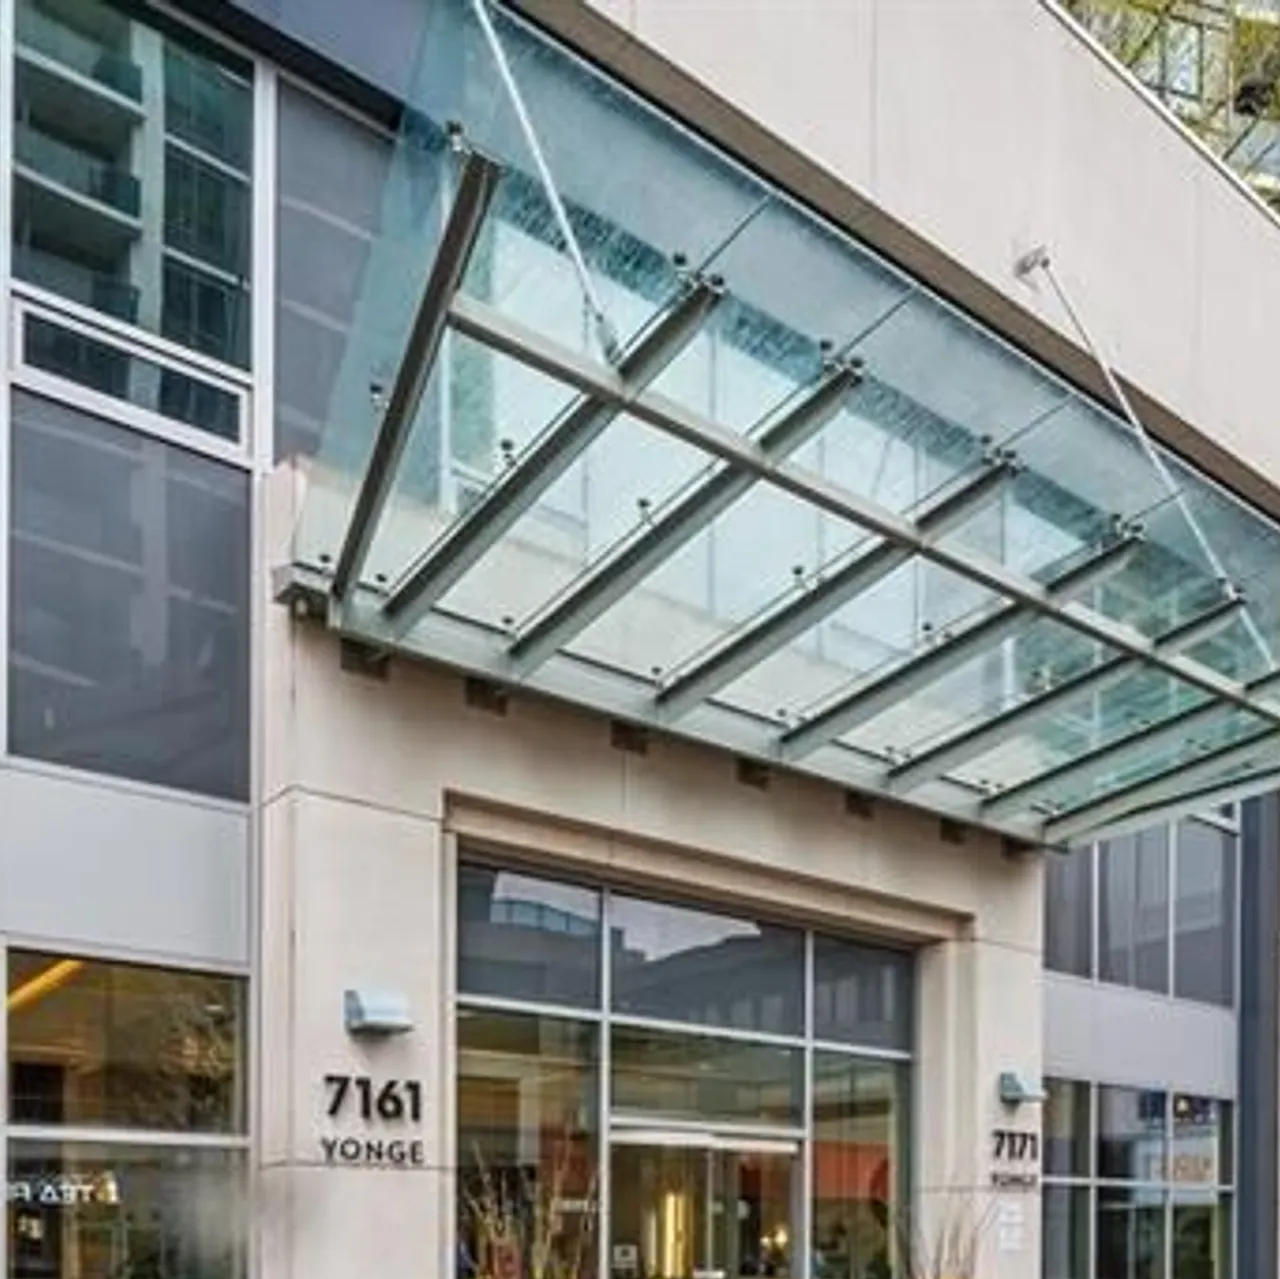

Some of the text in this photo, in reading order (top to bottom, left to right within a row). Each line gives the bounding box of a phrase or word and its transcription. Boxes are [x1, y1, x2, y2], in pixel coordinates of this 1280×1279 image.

[324, 1074, 421, 1122] 7161
[322, 1138, 424, 1163] YONGE
[992, 1130, 1038, 1161] 7171
